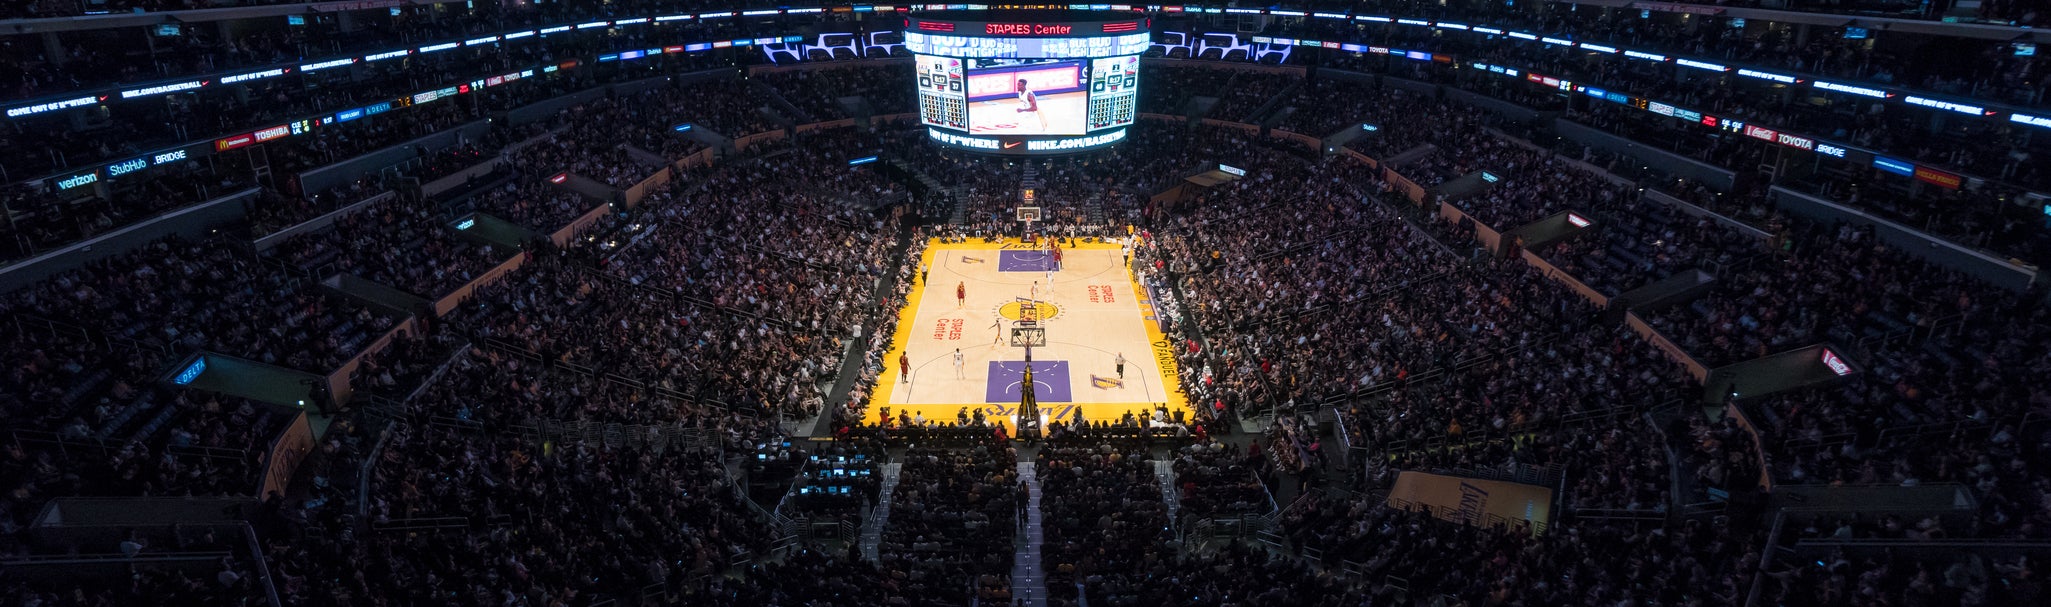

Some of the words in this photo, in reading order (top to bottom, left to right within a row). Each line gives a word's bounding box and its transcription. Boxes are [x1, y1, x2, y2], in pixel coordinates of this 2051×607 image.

[986, 24, 1030, 34] STAPLES
[1034, 24, 1071, 34] Center
[414, 91, 437, 104] STAPLES
[7, 106, 32, 117] COME
[31, 104, 48, 113] OUT
[48, 102, 58, 110] OF
[371, 103, 391, 113] DELTA
[1650, 102, 1674, 116] STAPLES
[254, 126, 290, 140] TOSHIBA
[1778, 133, 1812, 150] TOYOTA
[109, 158, 147, 176] StubHub
[58, 173, 98, 190] verizon
[1087, 285, 1099, 303] Center
[1101, 285, 1115, 303] STAPLES
[933, 318, 950, 341] Center
[949, 318, 964, 341] STAPLES
[182, 360, 205, 383] DELTA
[1156, 348, 1176, 378] FANDUEL
